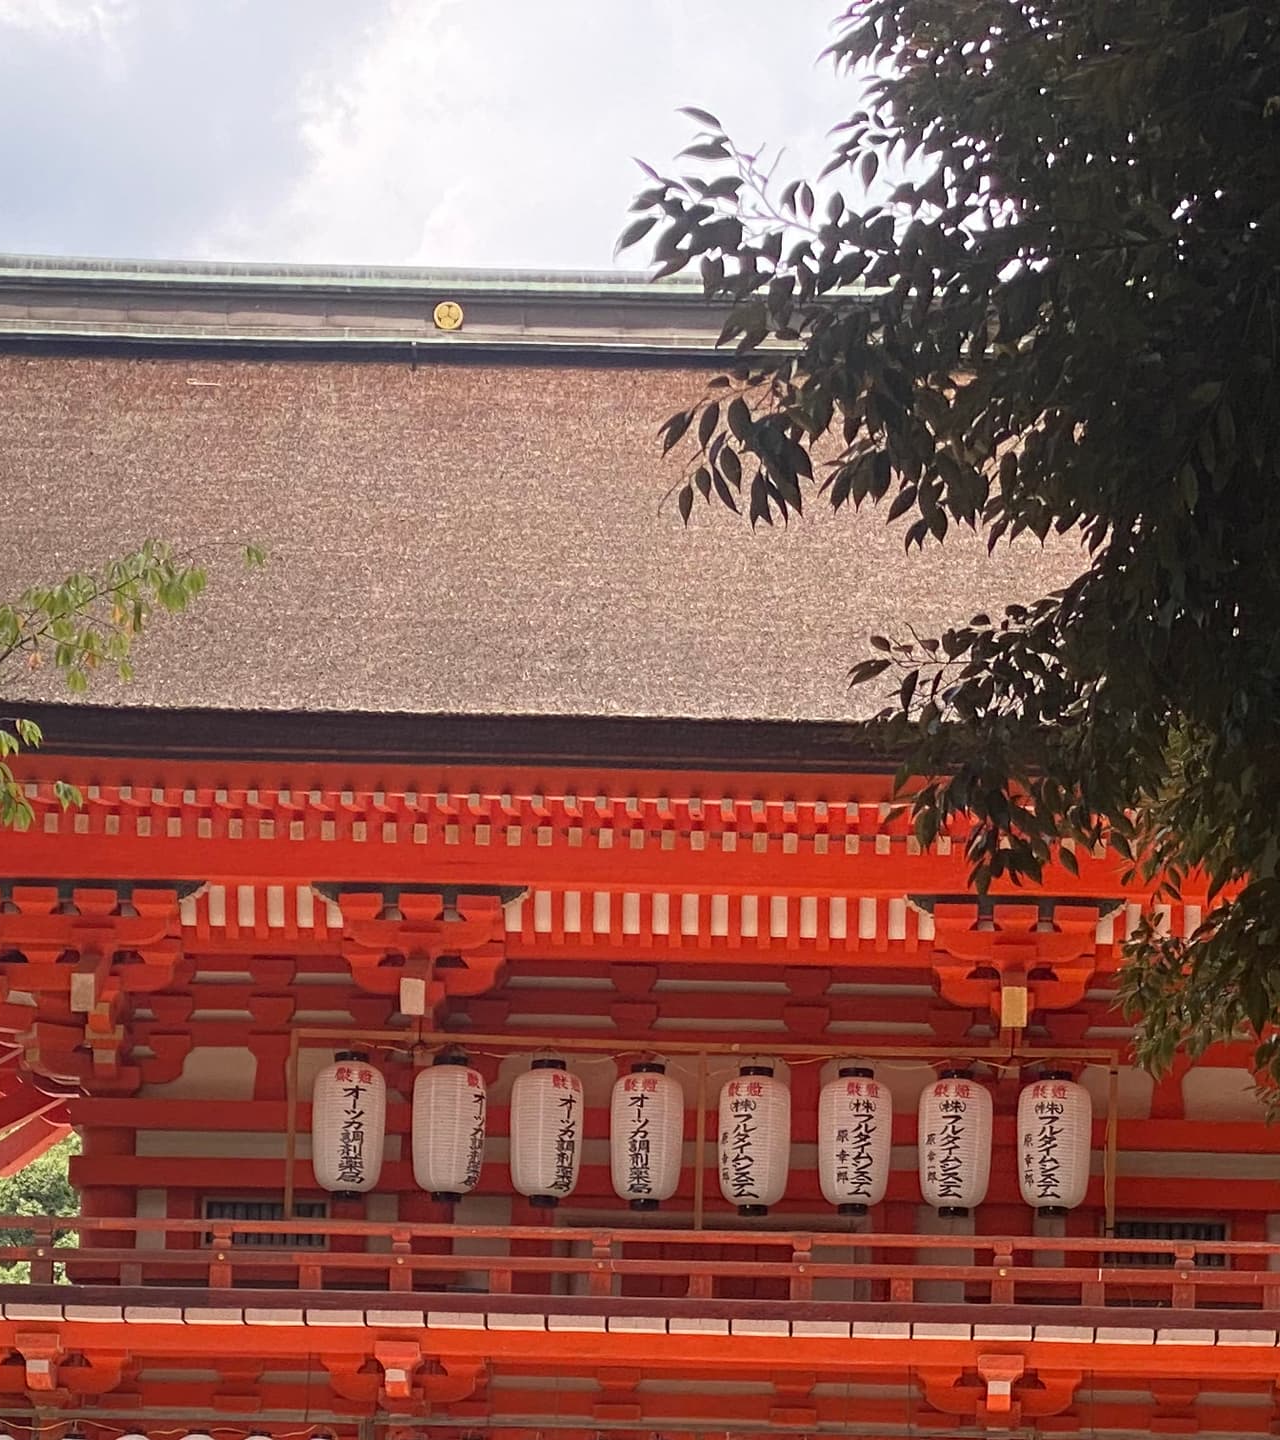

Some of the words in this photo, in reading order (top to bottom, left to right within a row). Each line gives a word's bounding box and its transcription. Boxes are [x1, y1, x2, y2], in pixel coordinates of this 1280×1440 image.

[336, 1085, 367, 1184] オーツカ調剤薬局
[546, 1094, 577, 1193] オーツカ調剤薬局
[626, 1093, 653, 1195] オーツカ調剤薬局
